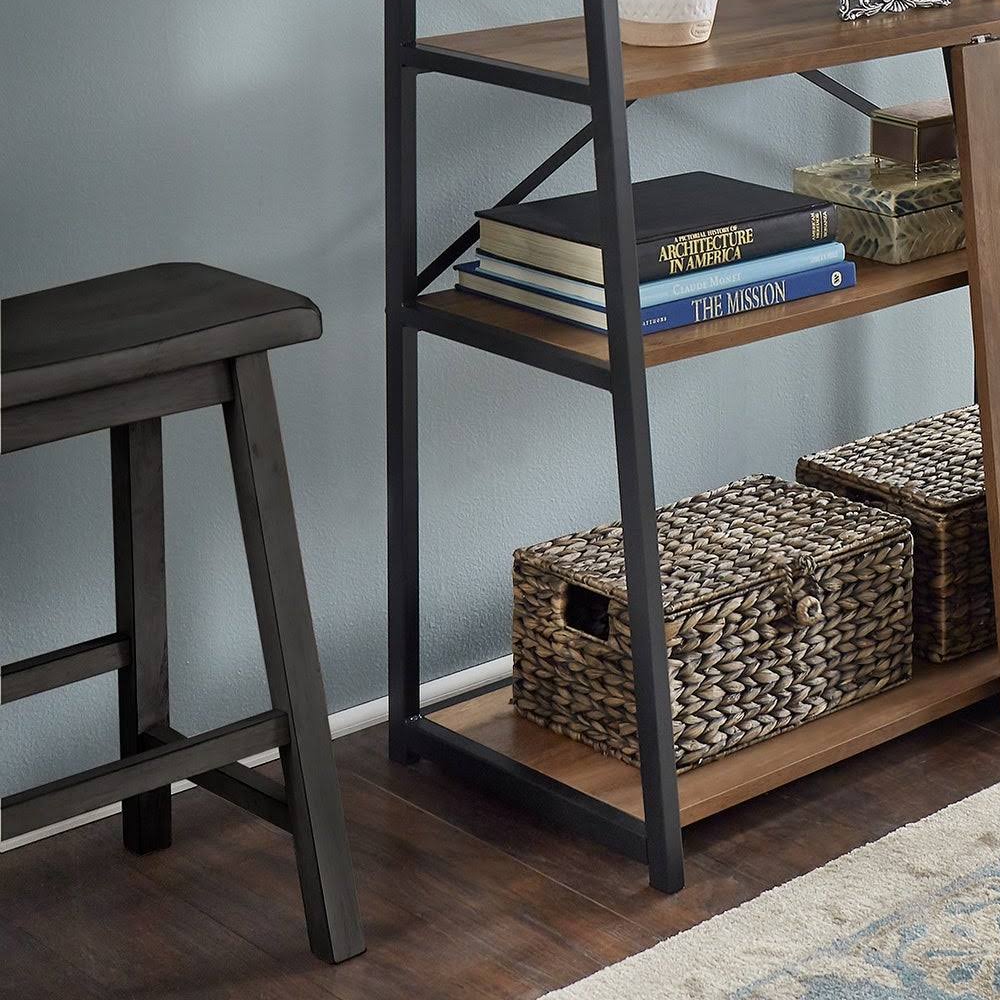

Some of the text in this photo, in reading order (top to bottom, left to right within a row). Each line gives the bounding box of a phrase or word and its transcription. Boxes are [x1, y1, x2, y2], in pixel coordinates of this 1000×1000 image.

[659, 228, 754, 262] ARCHITECTURE
[678, 231, 706, 242] PICTORIAL
[669, 246, 741, 275] IN AMERICA
[691, 280, 786, 323] THE MISSION
